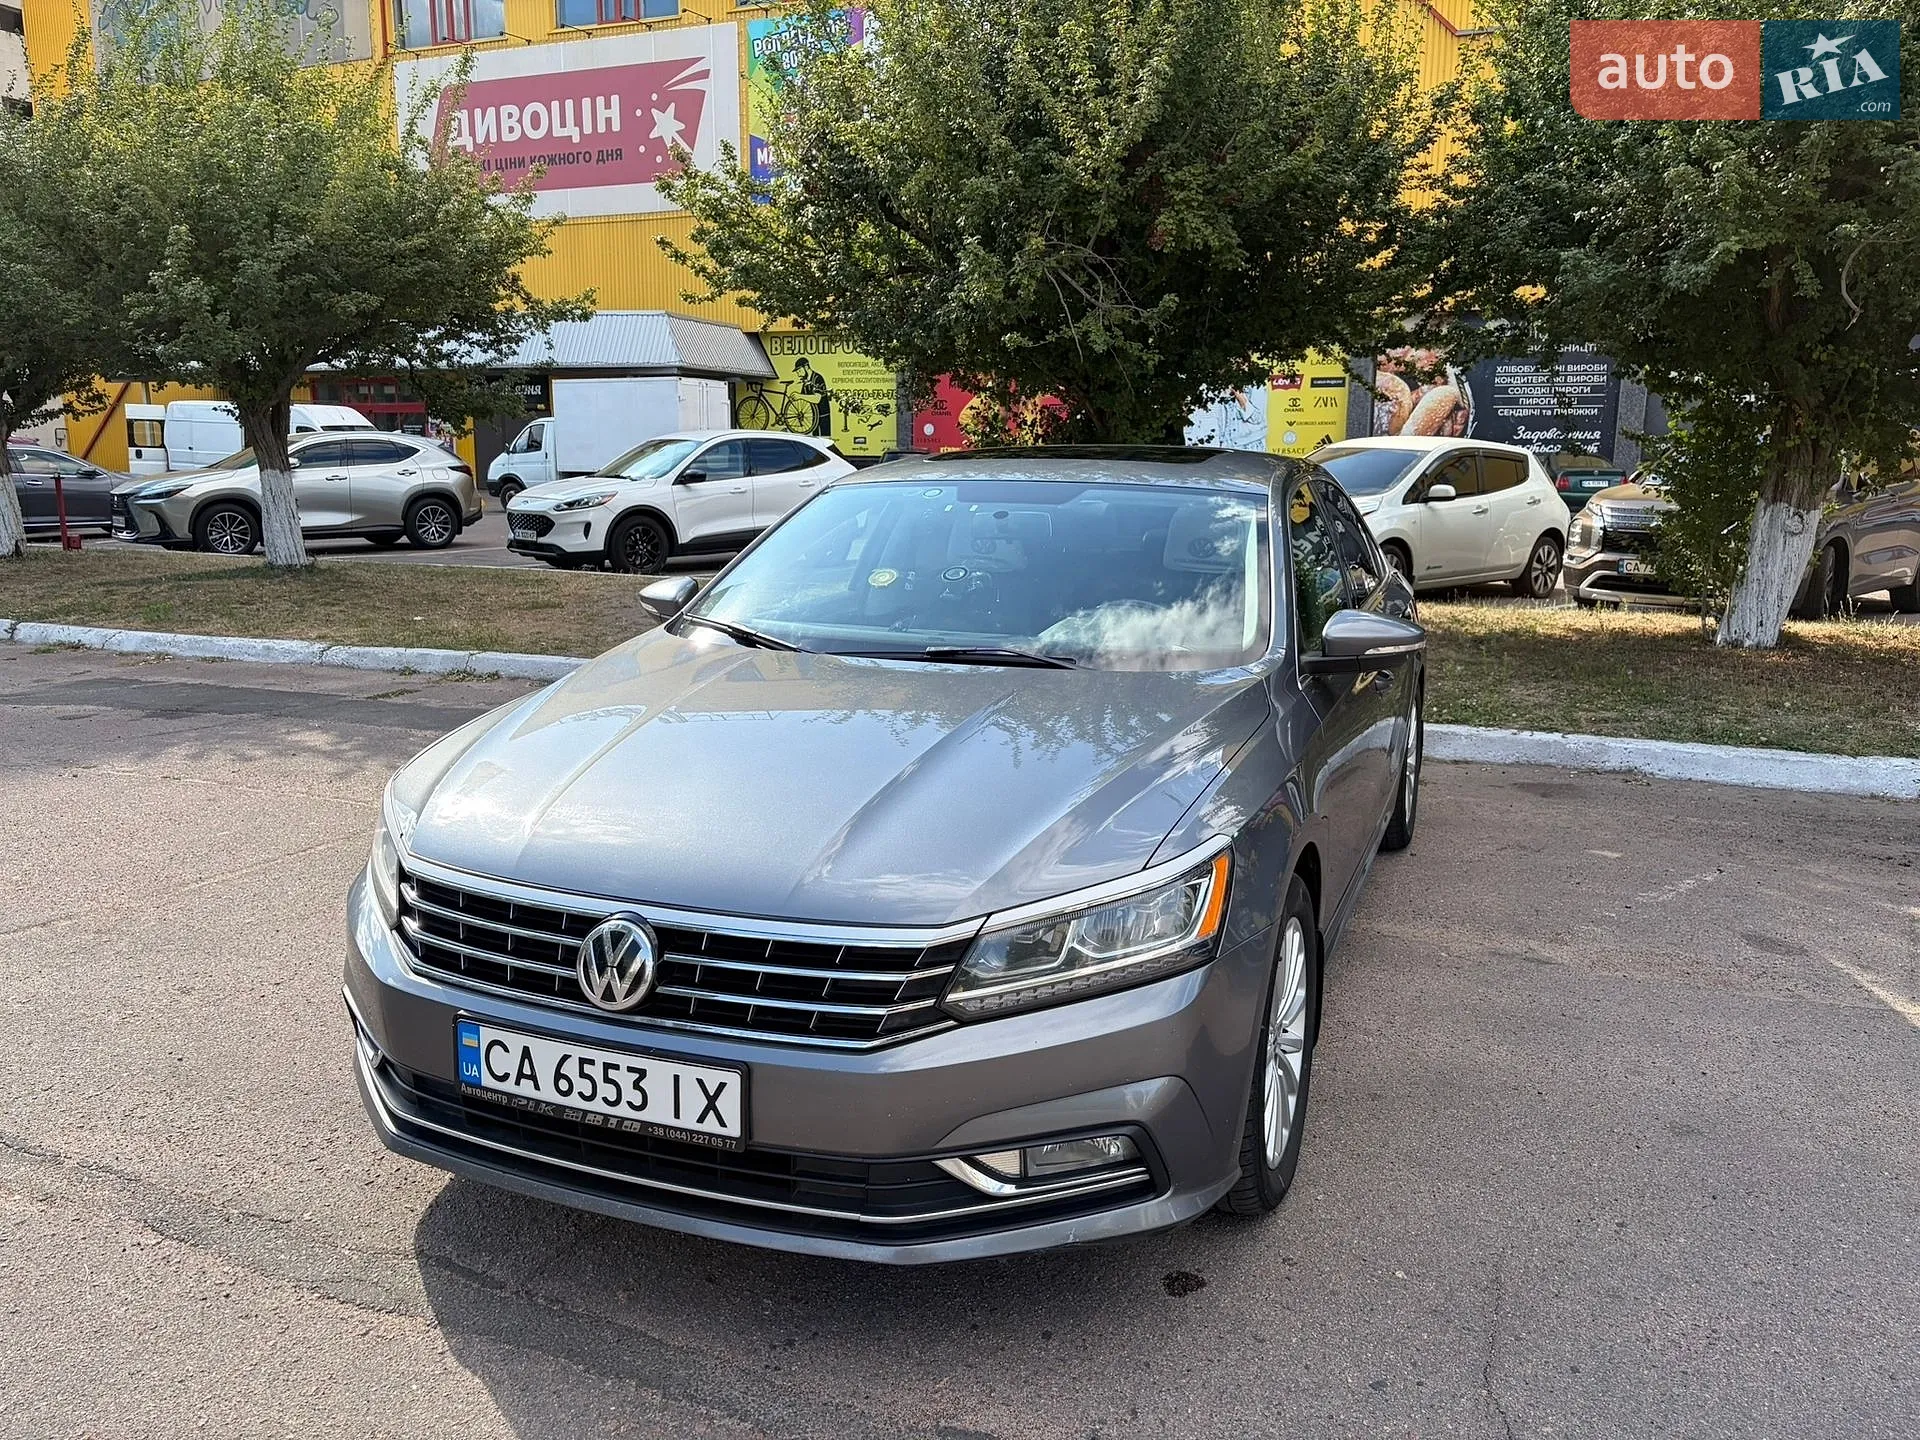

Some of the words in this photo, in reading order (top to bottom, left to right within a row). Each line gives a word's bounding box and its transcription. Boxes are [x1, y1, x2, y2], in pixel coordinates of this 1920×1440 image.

[454, 94, 622, 152] ДИВОЦІН
[495, 154, 527, 172] ЦІНИ
[529, 149, 593, 168] КОЖНОГО
[596, 147, 623, 165] ДНЯ
[770, 334, 864, 356] ВЕЛОПРО
[1567, 363, 1608, 373] ВИРОБИ
[1567, 374, 1607, 384] ВИРОБИ
[1508, 386, 1550, 395] СОЛОДКІ
[1519, 397, 1558, 406] ПИРОГИ
[1498, 408, 1541, 417] СЕНДВІЧІ
[1272, 447, 1305, 455] VERSACE
[1625, 562, 1640, 573] CA
[463, 1062, 479, 1078] UA
[484, 1039, 541, 1091] CA
[553, 1053, 648, 1112] 6553
[673, 1074, 727, 1128] IX
[461, 1083, 508, 1105] Автоцентр
[648, 1126, 664, 1136] +38
[666, 1128, 690, 1142] (044)
[692, 1133, 708, 1144] 227
[711, 1137, 723, 1147] 05
[726, 1140, 736, 1149] 77
